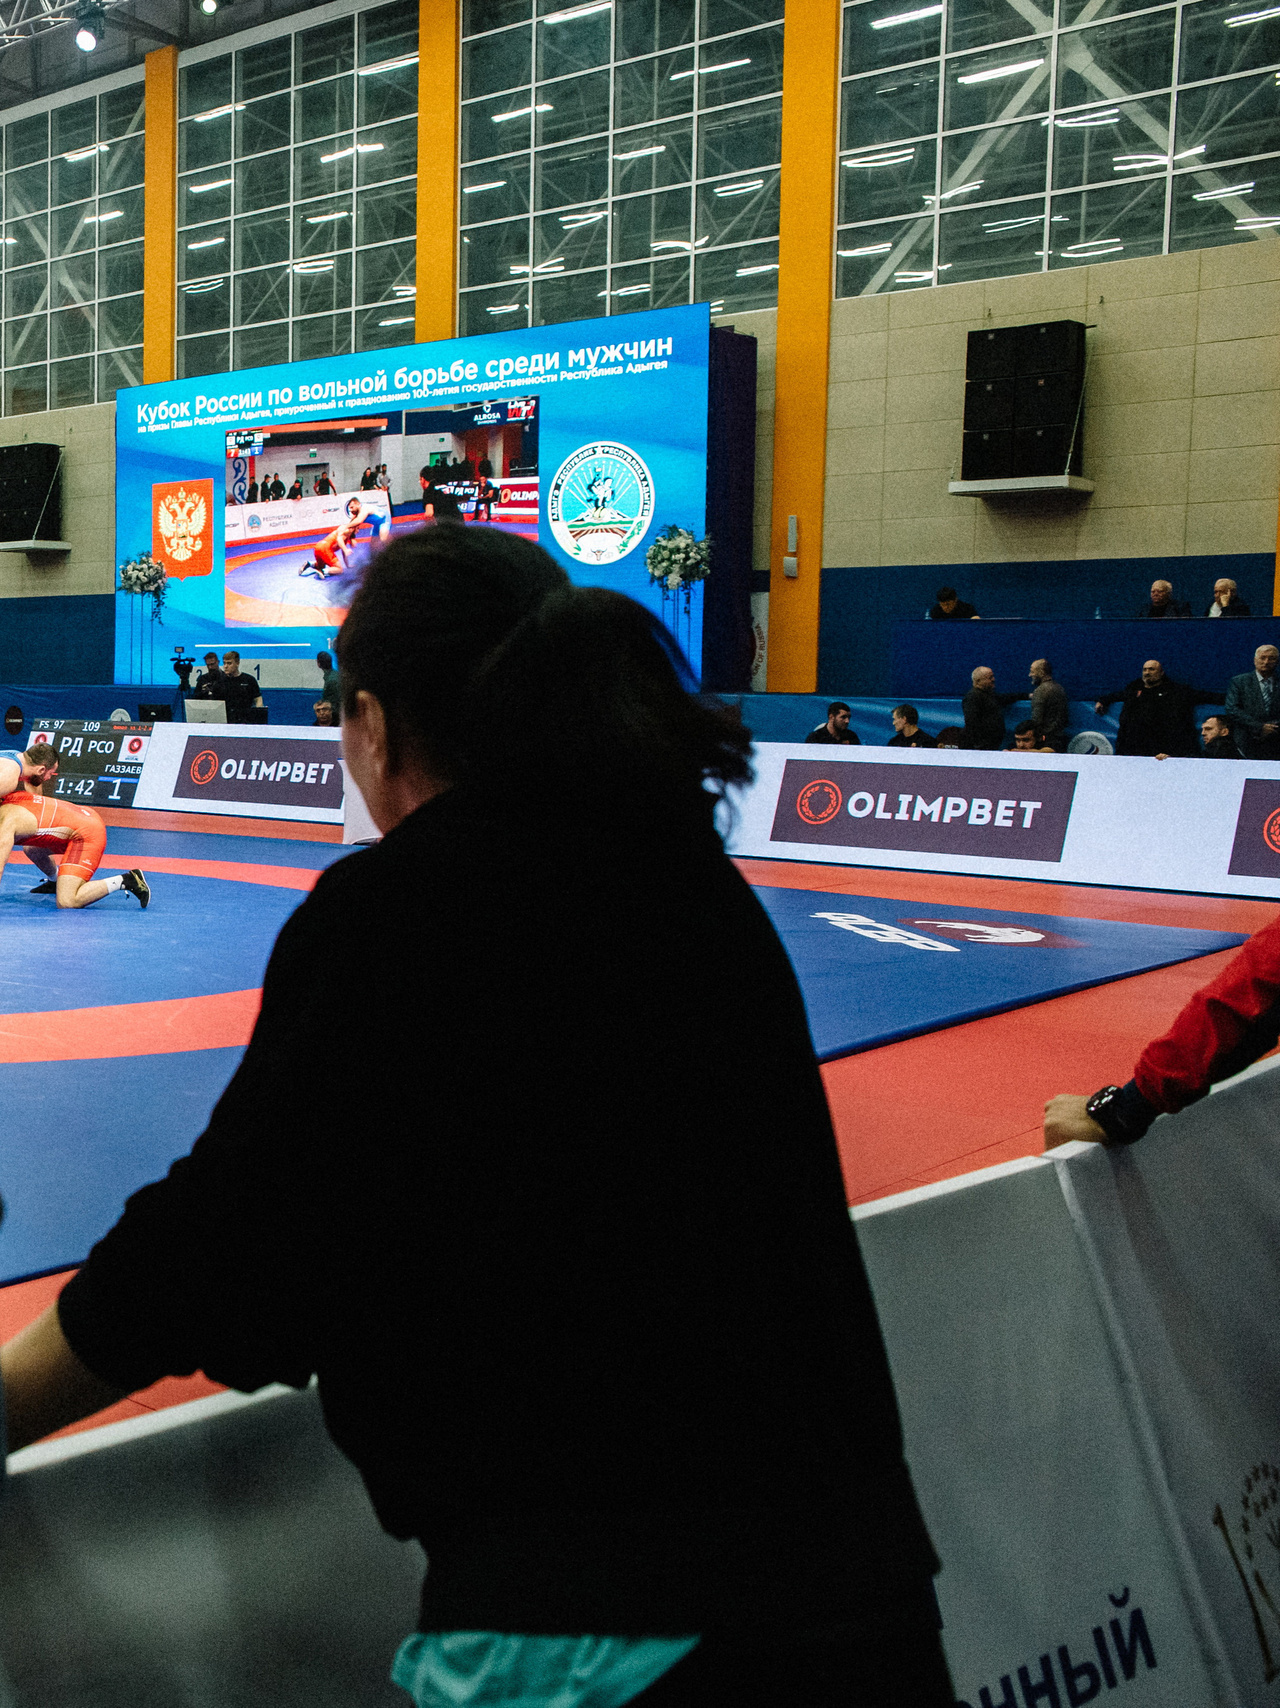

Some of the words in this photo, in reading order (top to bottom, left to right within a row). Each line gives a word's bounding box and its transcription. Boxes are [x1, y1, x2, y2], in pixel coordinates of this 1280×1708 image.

[137, 400, 191, 426] Кубок
[195, 391, 262, 415] России
[268, 387, 293, 406] по
[298, 369, 388, 401] вольной
[394, 359, 478, 391] борьбе
[485, 351, 560, 380] среди
[568, 337, 673, 369] мужчин
[137, 425, 147, 433] на
[148, 422, 170, 432] призы
[171, 419, 193, 429] Главы
[194, 414, 239, 427] Республики
[240, 409, 272, 421] Адыгея,
[274, 401, 336, 417] приуроченный
[338, 400, 344, 408] к
[345, 391, 410, 408] празднованию
[412, 386, 459, 399] 100-летия
[461, 373, 558, 394] государственности
[560, 366, 623, 381] Республика
[626, 360, 668, 374] Адыгея
[253, 664, 260, 681] 1
[39, 720, 50, 728] FS
[53, 720, 65, 729] 97
[82, 721, 100, 731] 109
[59, 736, 84, 757] РД
[87, 740, 115, 753] РСО
[104, 764, 142, 774] ГАЗЗАЕВ
[220, 757, 335, 785] OLIMPBET
[55, 778, 95, 796] 1:42
[108, 778, 122, 800] 1
[847, 790, 1043, 829] OLIMPBET
